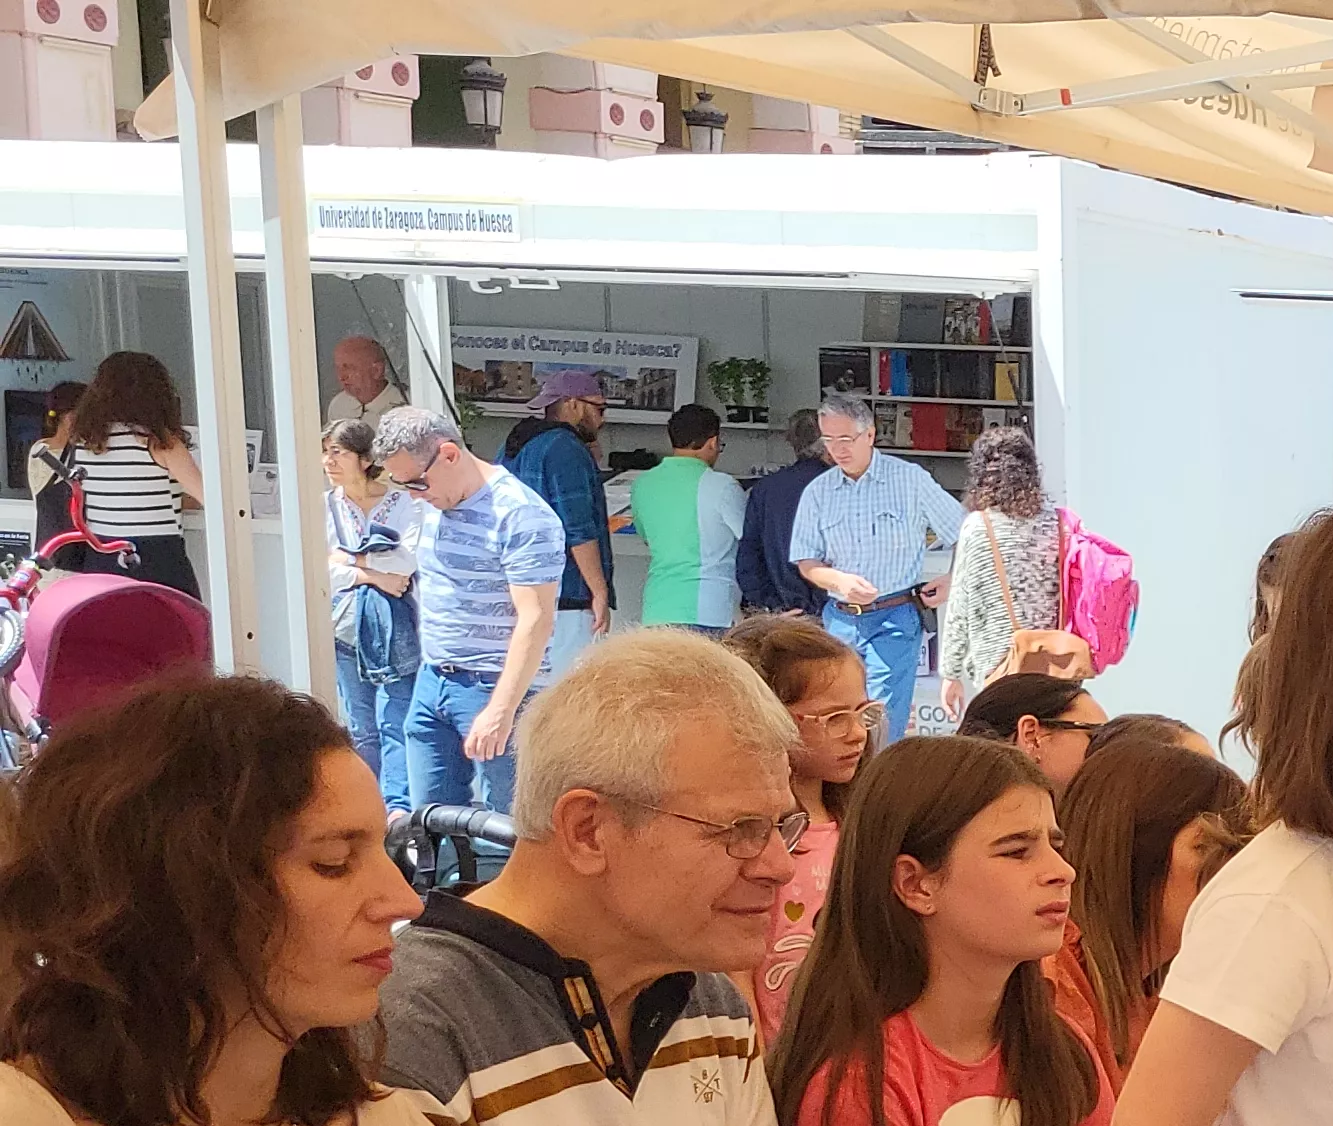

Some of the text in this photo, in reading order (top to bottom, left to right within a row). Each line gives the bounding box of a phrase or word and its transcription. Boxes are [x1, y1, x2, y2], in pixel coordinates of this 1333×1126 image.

[318, 205, 371, 229] Universidad
[372, 206, 383, 229] de
[428, 208, 464, 233] Campus
[465, 209, 477, 232] de
[478, 210, 514, 233] Huesca
[511, 334, 526, 351] el
[528, 335, 589, 356] Campus
[592, 338, 611, 355] de
[615, 339, 682, 358] Huesca?
